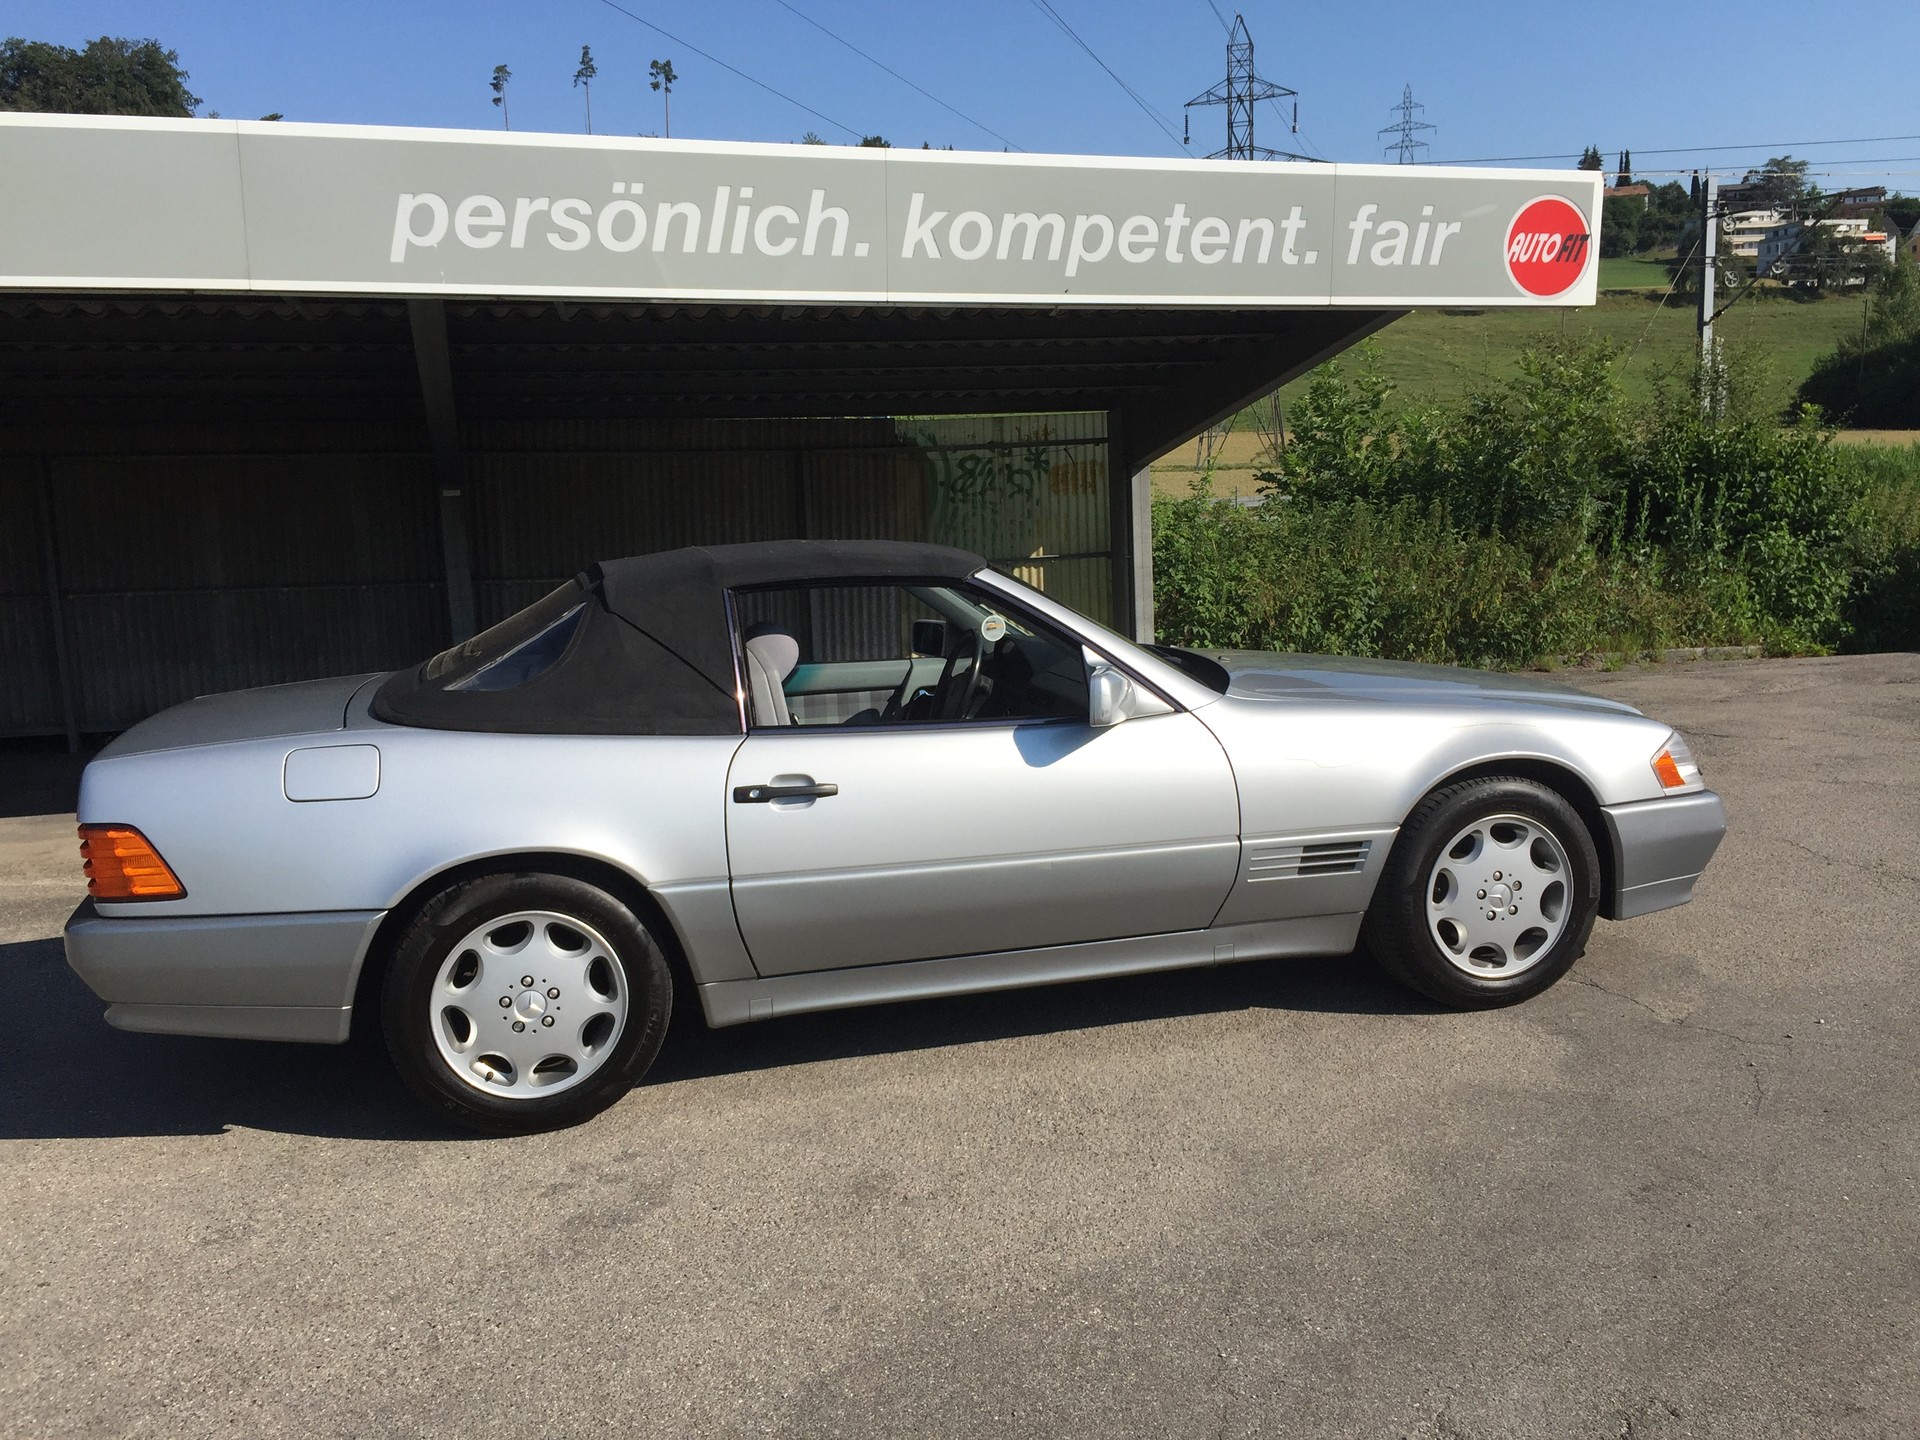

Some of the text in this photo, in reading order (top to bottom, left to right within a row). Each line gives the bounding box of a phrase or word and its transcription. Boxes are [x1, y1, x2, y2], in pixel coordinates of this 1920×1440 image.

[390, 181, 1463, 276] persönlich. kompetent. fair
[1508, 232, 1591, 263] AUTOFIT
